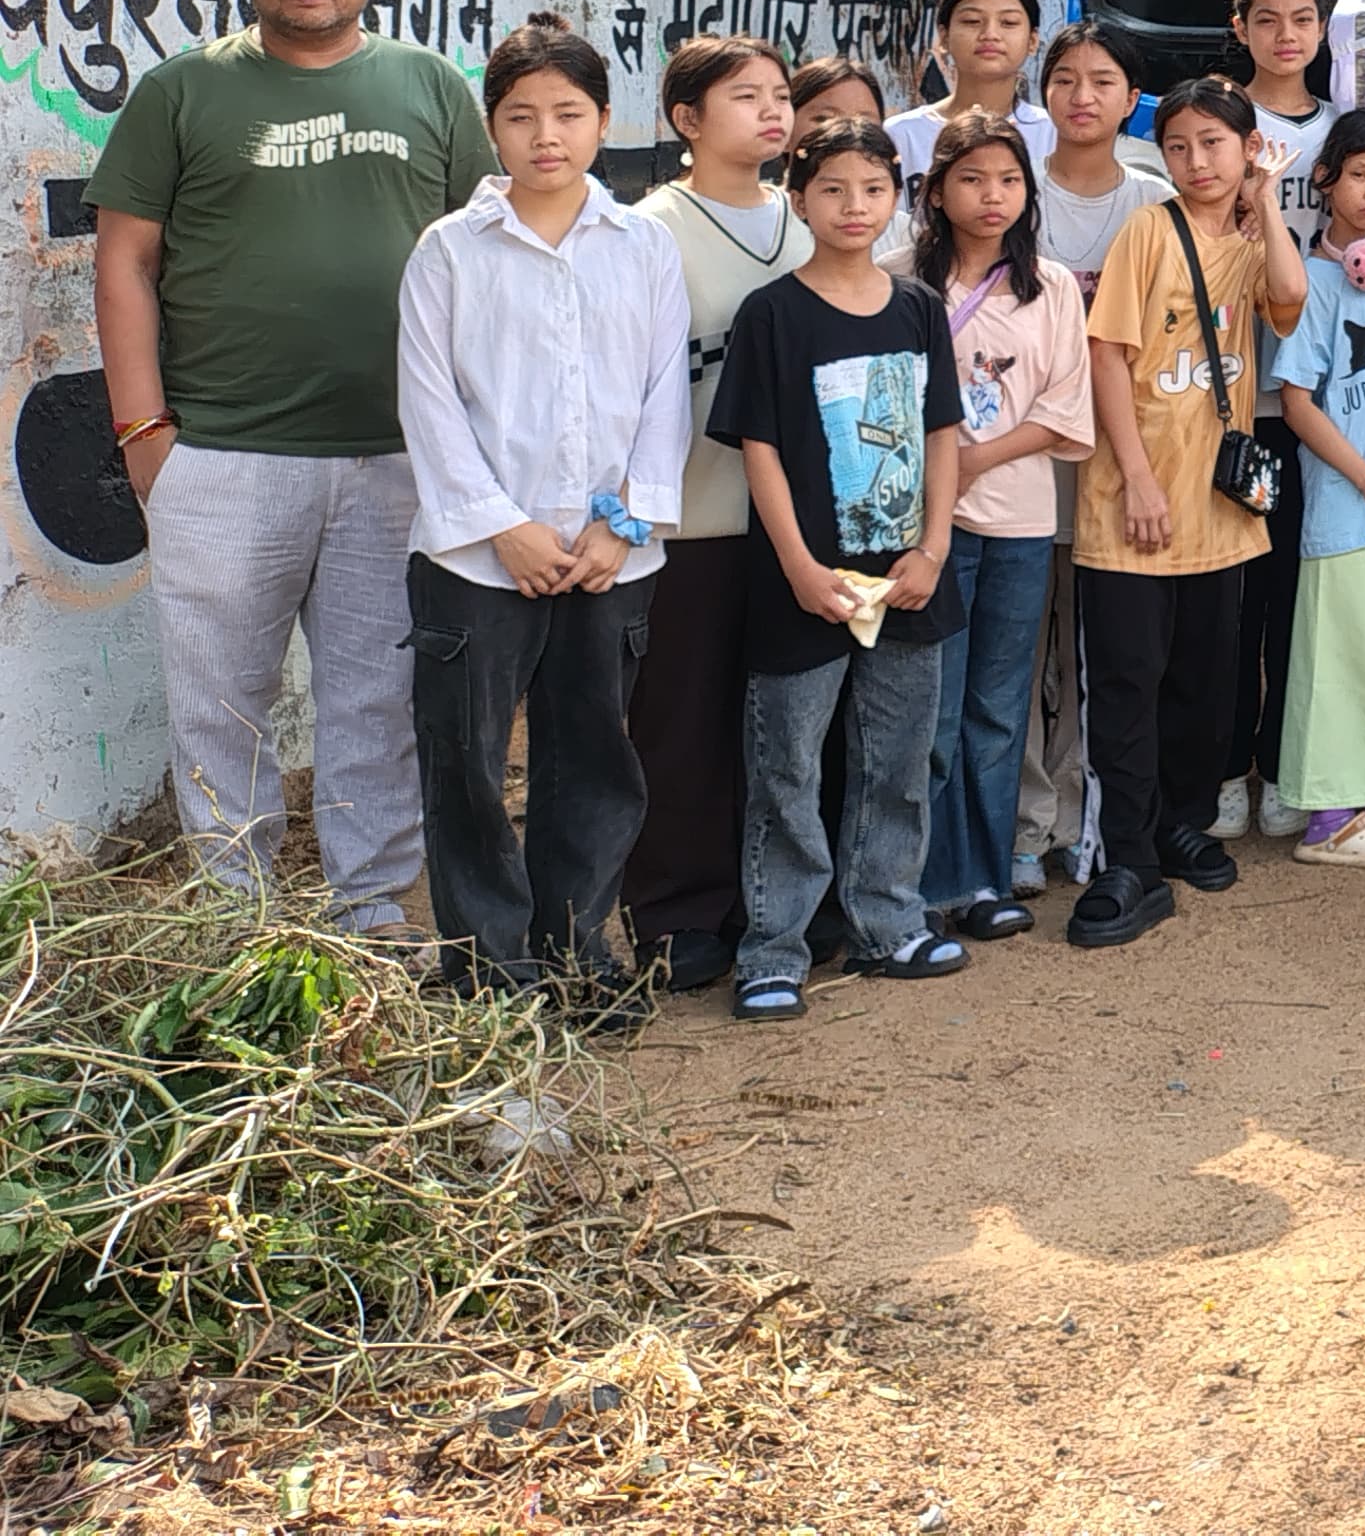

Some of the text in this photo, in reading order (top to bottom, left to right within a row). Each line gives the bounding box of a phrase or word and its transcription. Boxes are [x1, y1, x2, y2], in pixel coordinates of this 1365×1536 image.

[262, 112, 347, 145] VISION
[256, 130, 409, 168] OUT OF FOCUS
[879, 458, 917, 507] STOP
